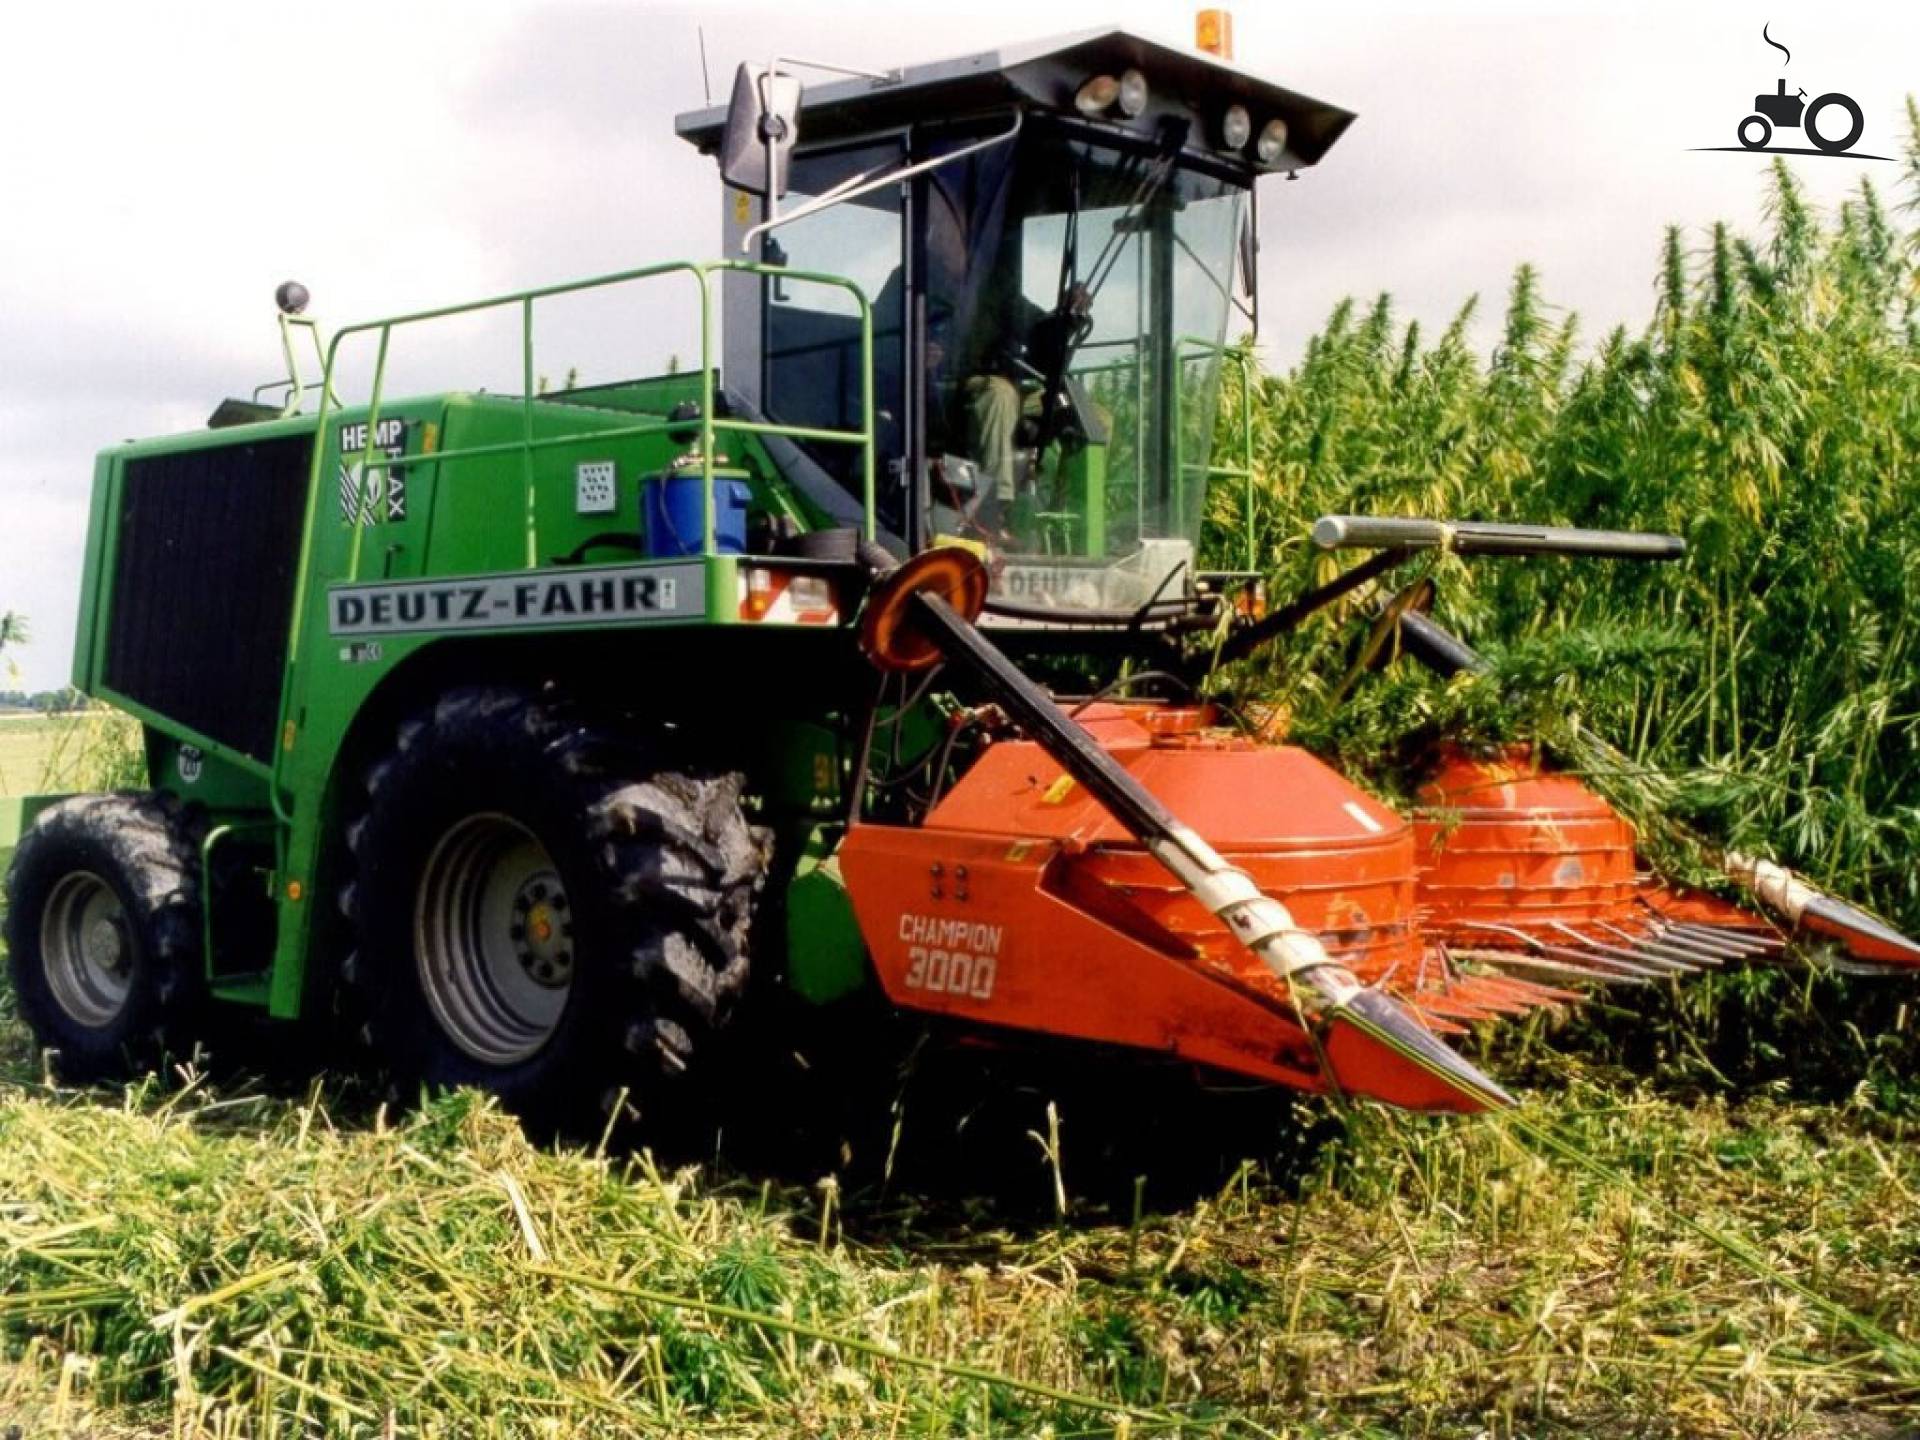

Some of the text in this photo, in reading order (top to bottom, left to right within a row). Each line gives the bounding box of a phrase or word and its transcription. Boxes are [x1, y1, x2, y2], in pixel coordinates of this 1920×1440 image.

[337, 576, 659, 628] DEUTZ-FAHR
[1009, 570, 1088, 596] DEUT
[899, 913, 1003, 953] CHAMPION
[904, 946, 996, 1000] 3000
